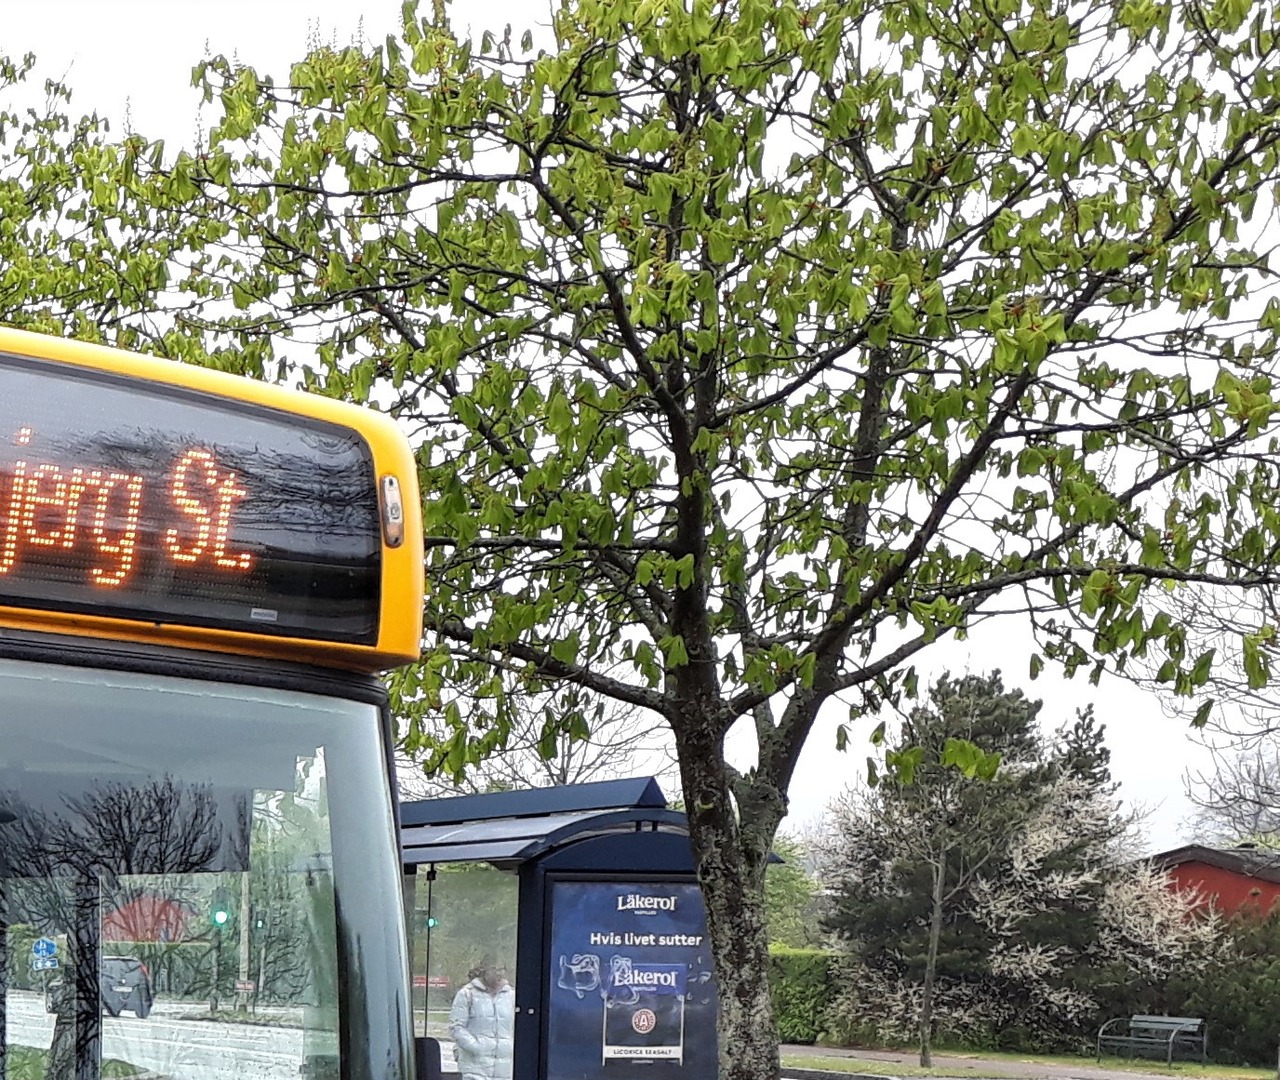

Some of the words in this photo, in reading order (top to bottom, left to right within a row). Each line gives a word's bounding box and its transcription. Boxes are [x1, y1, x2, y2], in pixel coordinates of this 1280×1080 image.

[164, 448, 252, 569] St.
[617, 894, 677, 911] Läkerol
[590, 932, 621, 946] Hvis
[624, 932, 655, 946] livet
[659, 933, 703, 947] sutter
